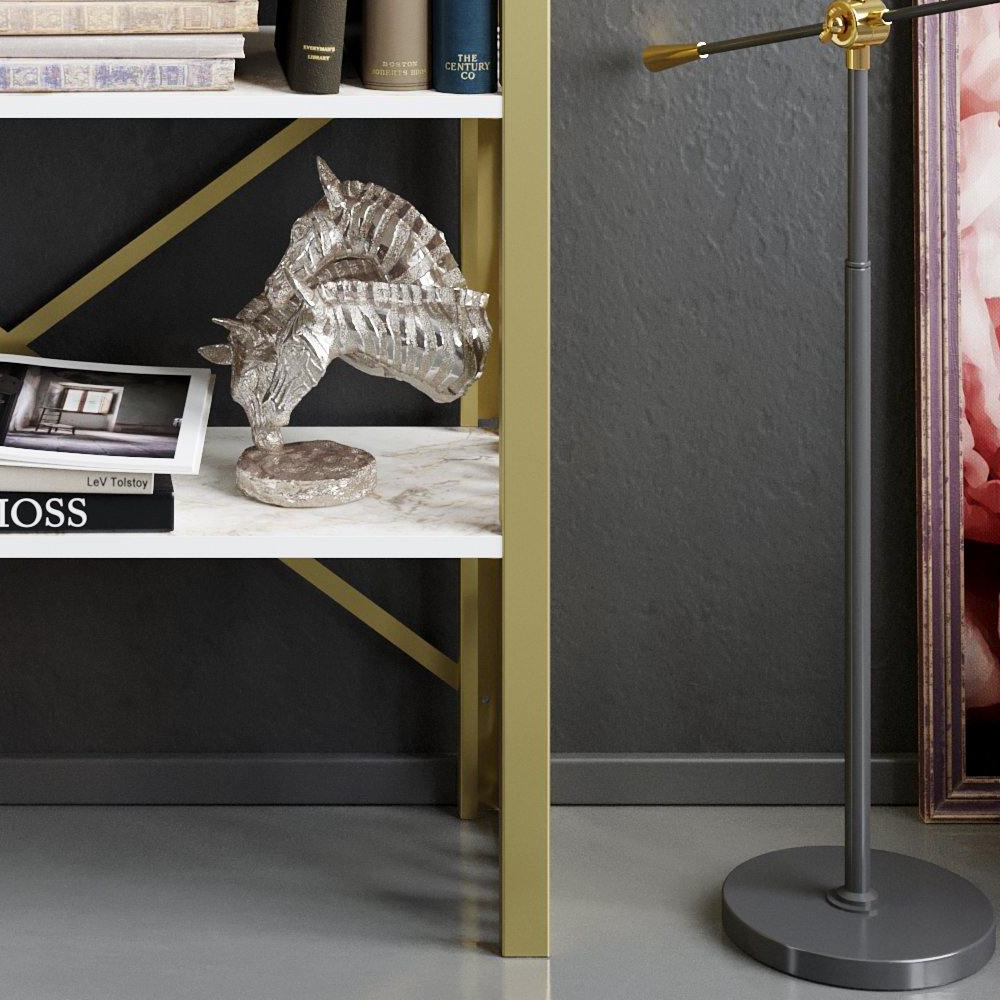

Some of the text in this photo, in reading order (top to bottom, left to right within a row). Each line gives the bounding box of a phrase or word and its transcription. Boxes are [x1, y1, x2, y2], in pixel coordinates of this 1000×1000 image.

[457, 53, 478, 62] THE
[444, 62, 490, 71] CENTURY
[460, 71, 476, 80] CO
[86, 476, 149, 490] LeV Tolstoy
